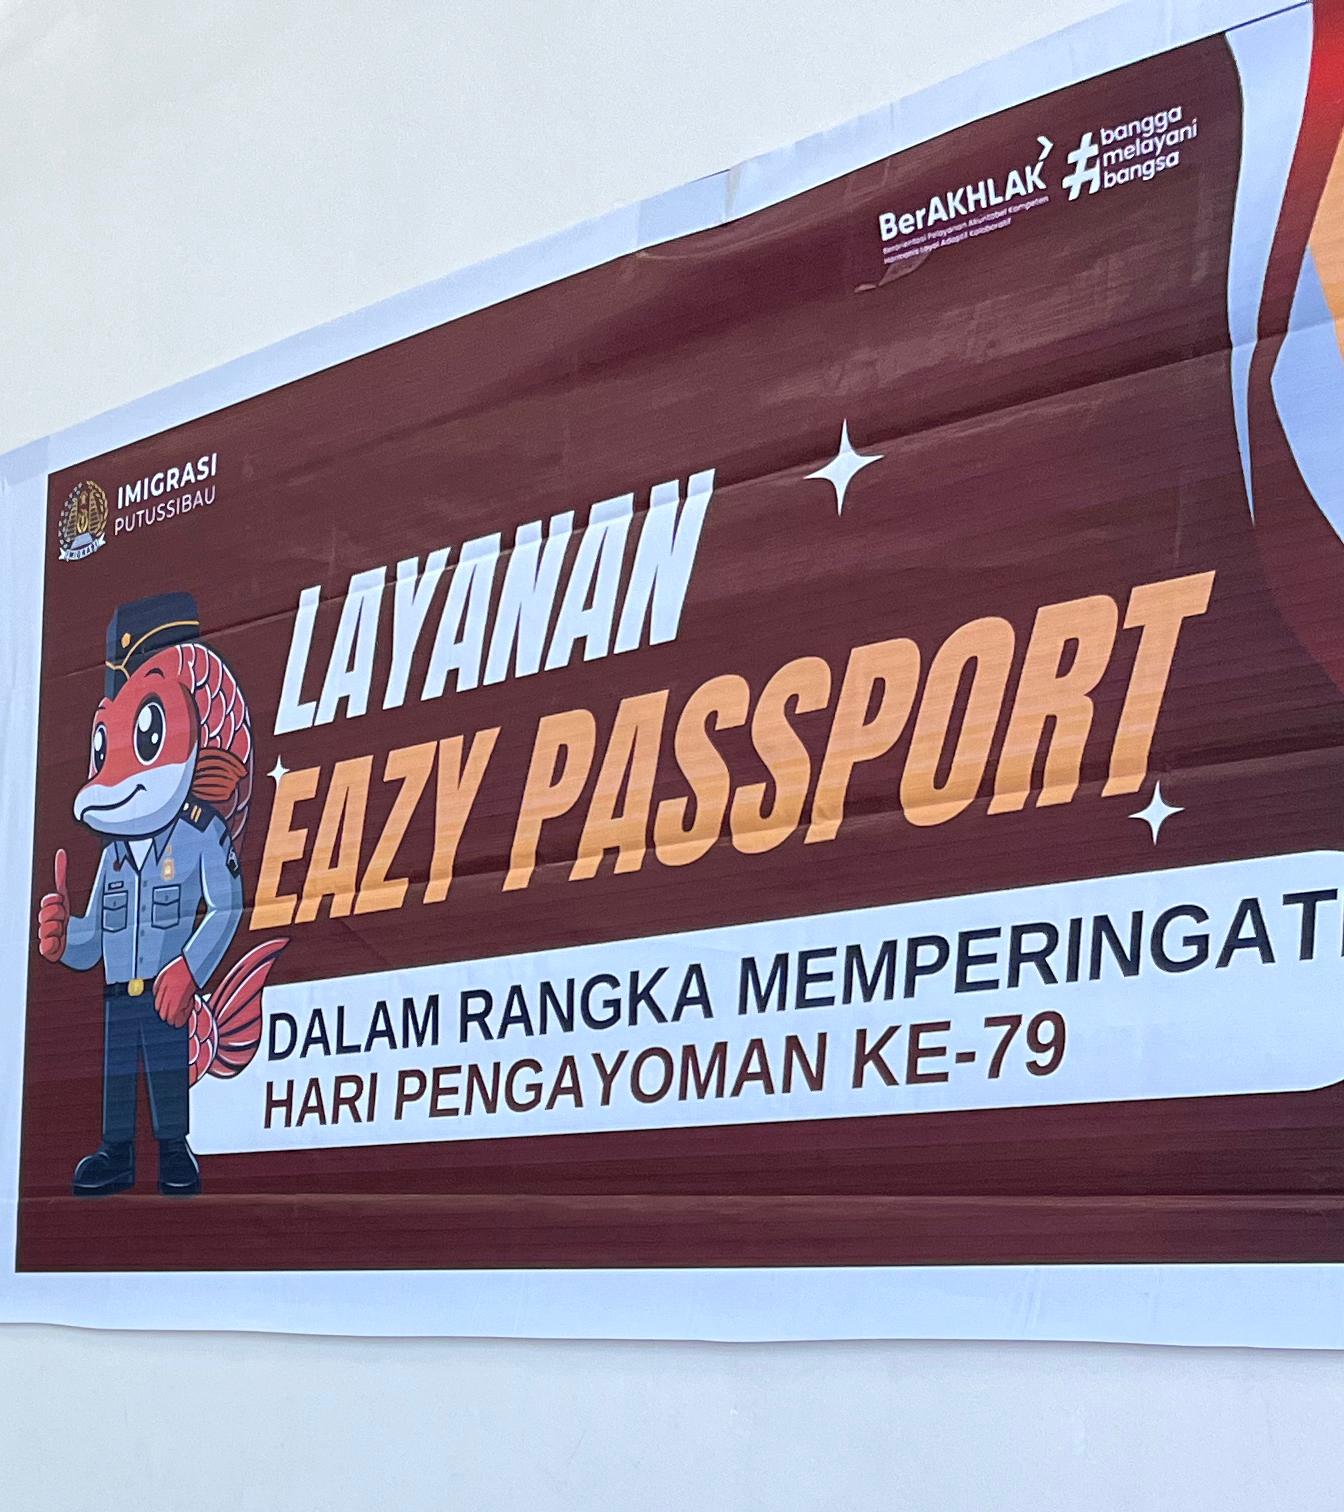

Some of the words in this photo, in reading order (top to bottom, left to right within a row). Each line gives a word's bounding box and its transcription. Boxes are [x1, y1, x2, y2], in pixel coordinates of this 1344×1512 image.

[1100, 106, 1183, 146] bangga
[1103, 117, 1198, 167] melayani
[878, 160, 1047, 242] BerAKHLAK
[1103, 151, 1180, 189] bangsa
[113, 485, 217, 536] PUTUSSIBAU
[117, 452, 218, 510] IMIGRASI
[273, 467, 716, 736] LAYANAN
[249, 729, 500, 931] EAZY
[505, 571, 1217, 891] PASSPORT
[267, 993, 441, 1062] DALAM
[459, 962, 715, 1045] RANGKA
[737, 887, 1344, 1016] MEMPERINGAT
[263, 1072, 379, 1129] HARI
[393, 1031, 828, 1121] PENGAYOMAN
[851, 1010, 1068, 1088] KE-79
